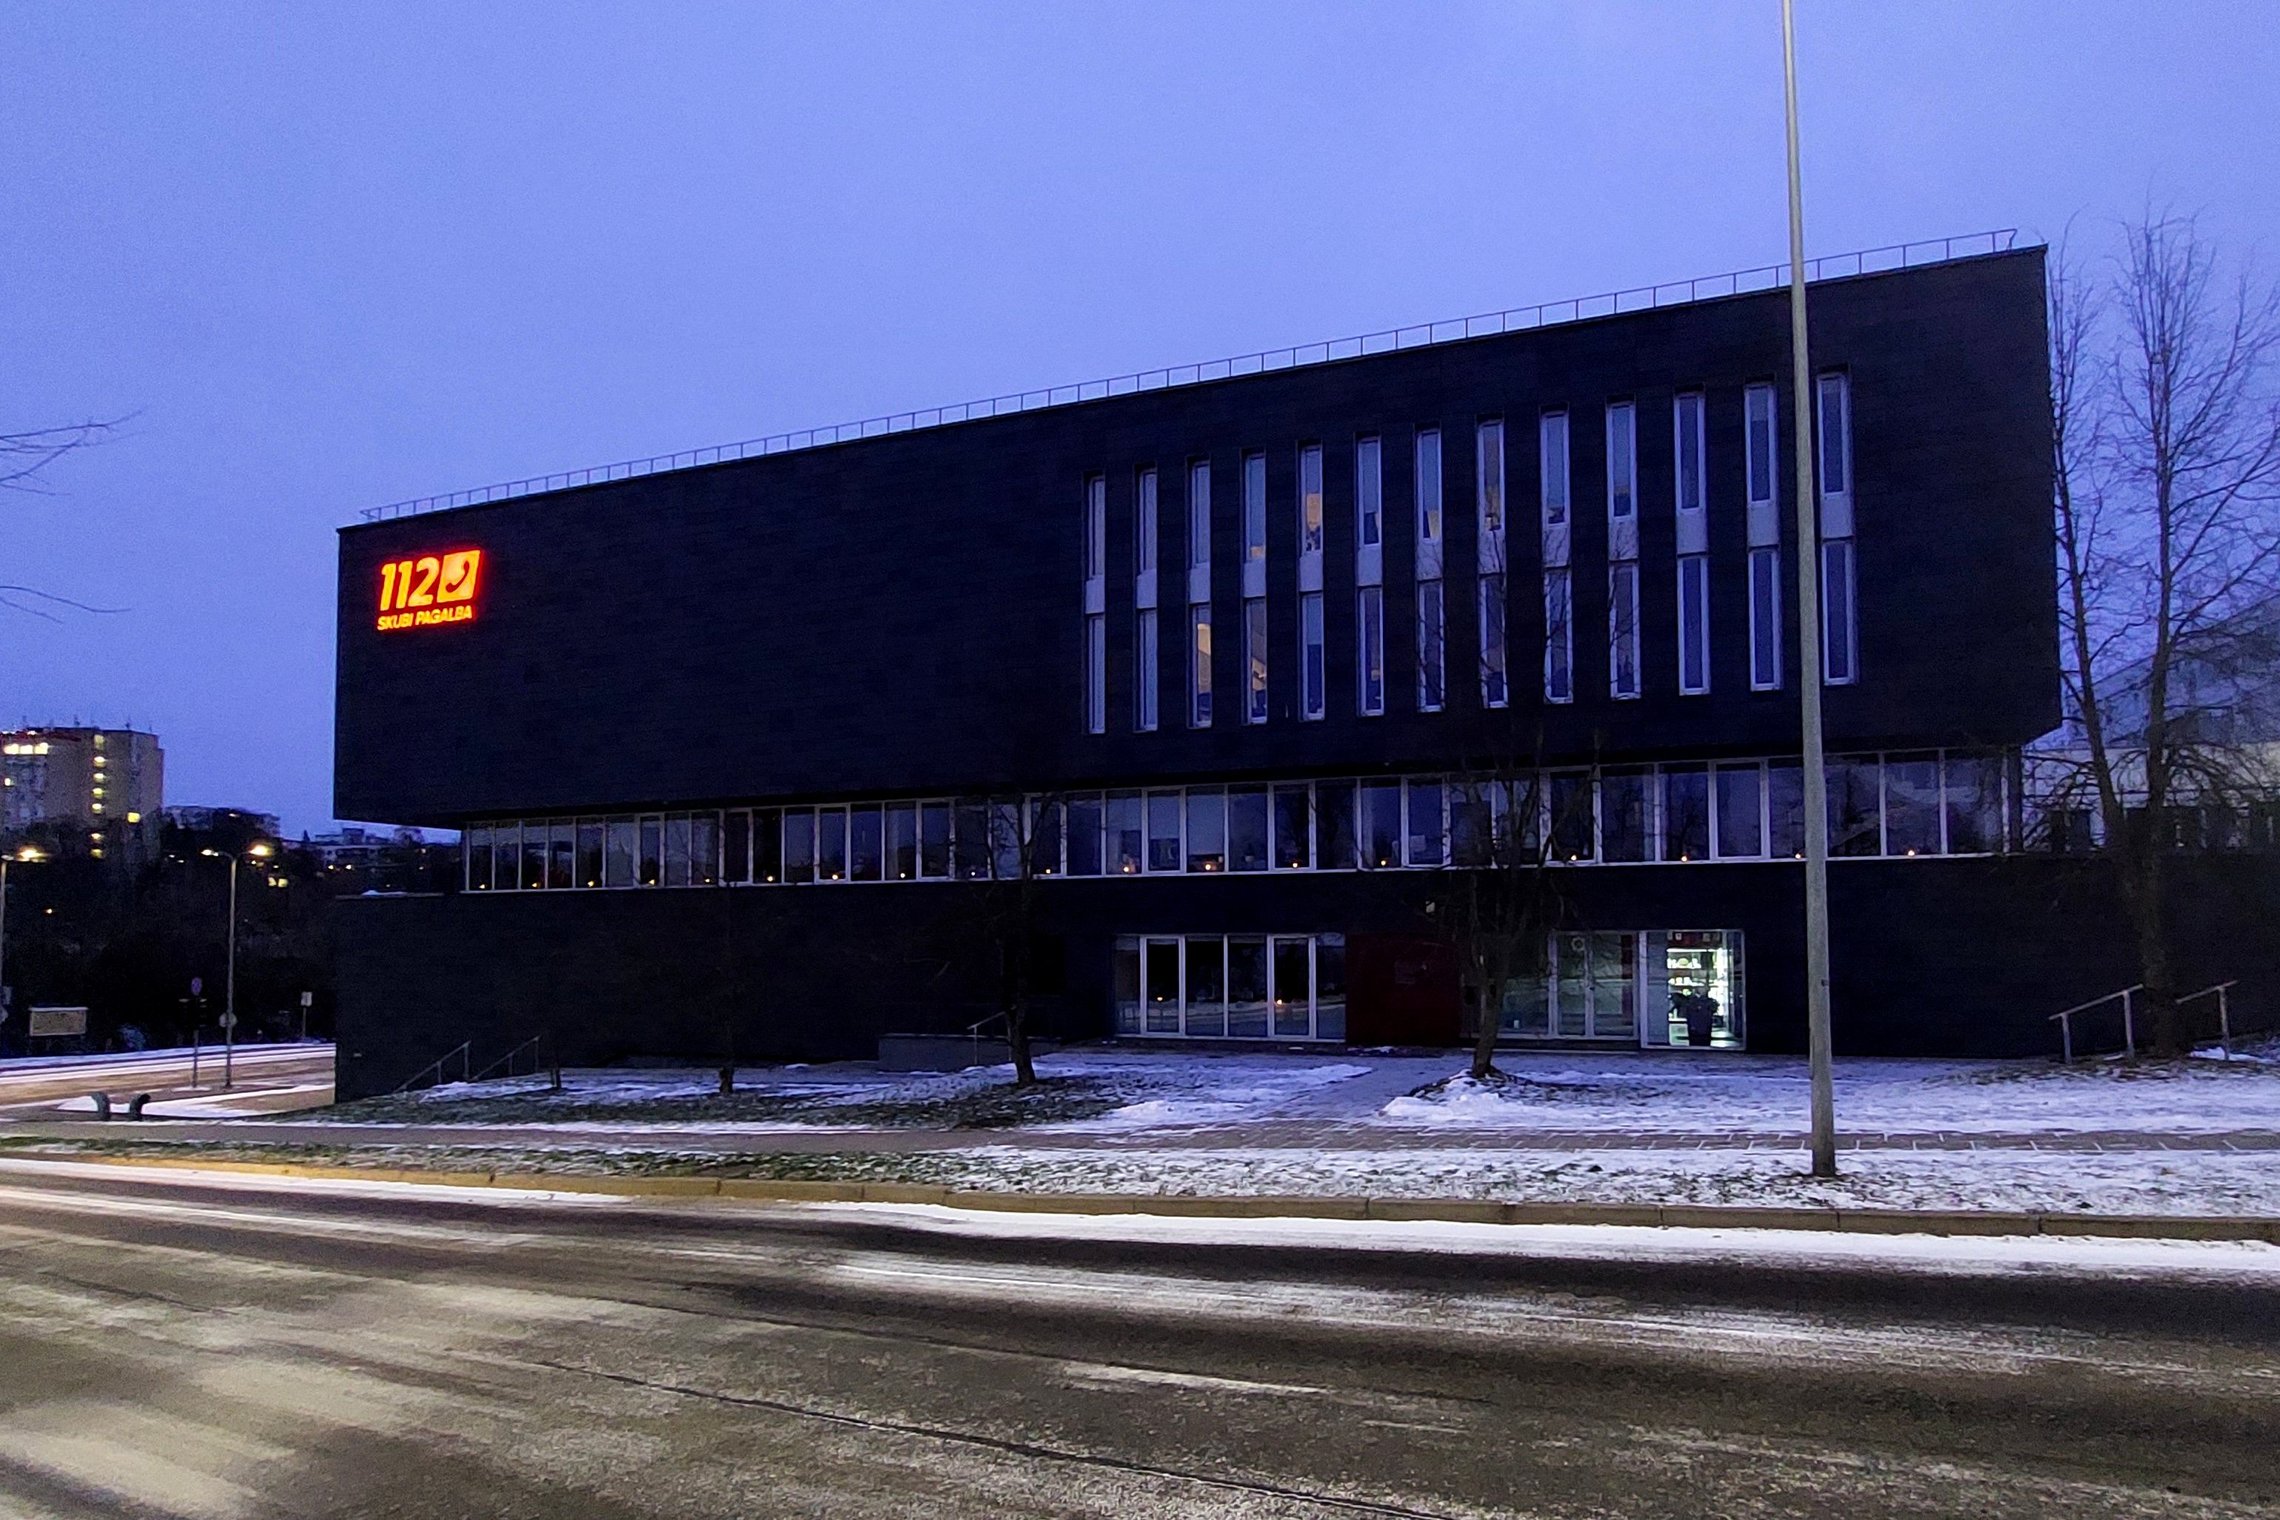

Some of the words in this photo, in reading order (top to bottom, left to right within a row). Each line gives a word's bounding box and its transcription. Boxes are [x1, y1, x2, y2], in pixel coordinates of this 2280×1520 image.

[380, 556, 440, 611] 112
[377, 613, 414, 630] SKUBI
[415, 605, 472, 625] PAGALBA
